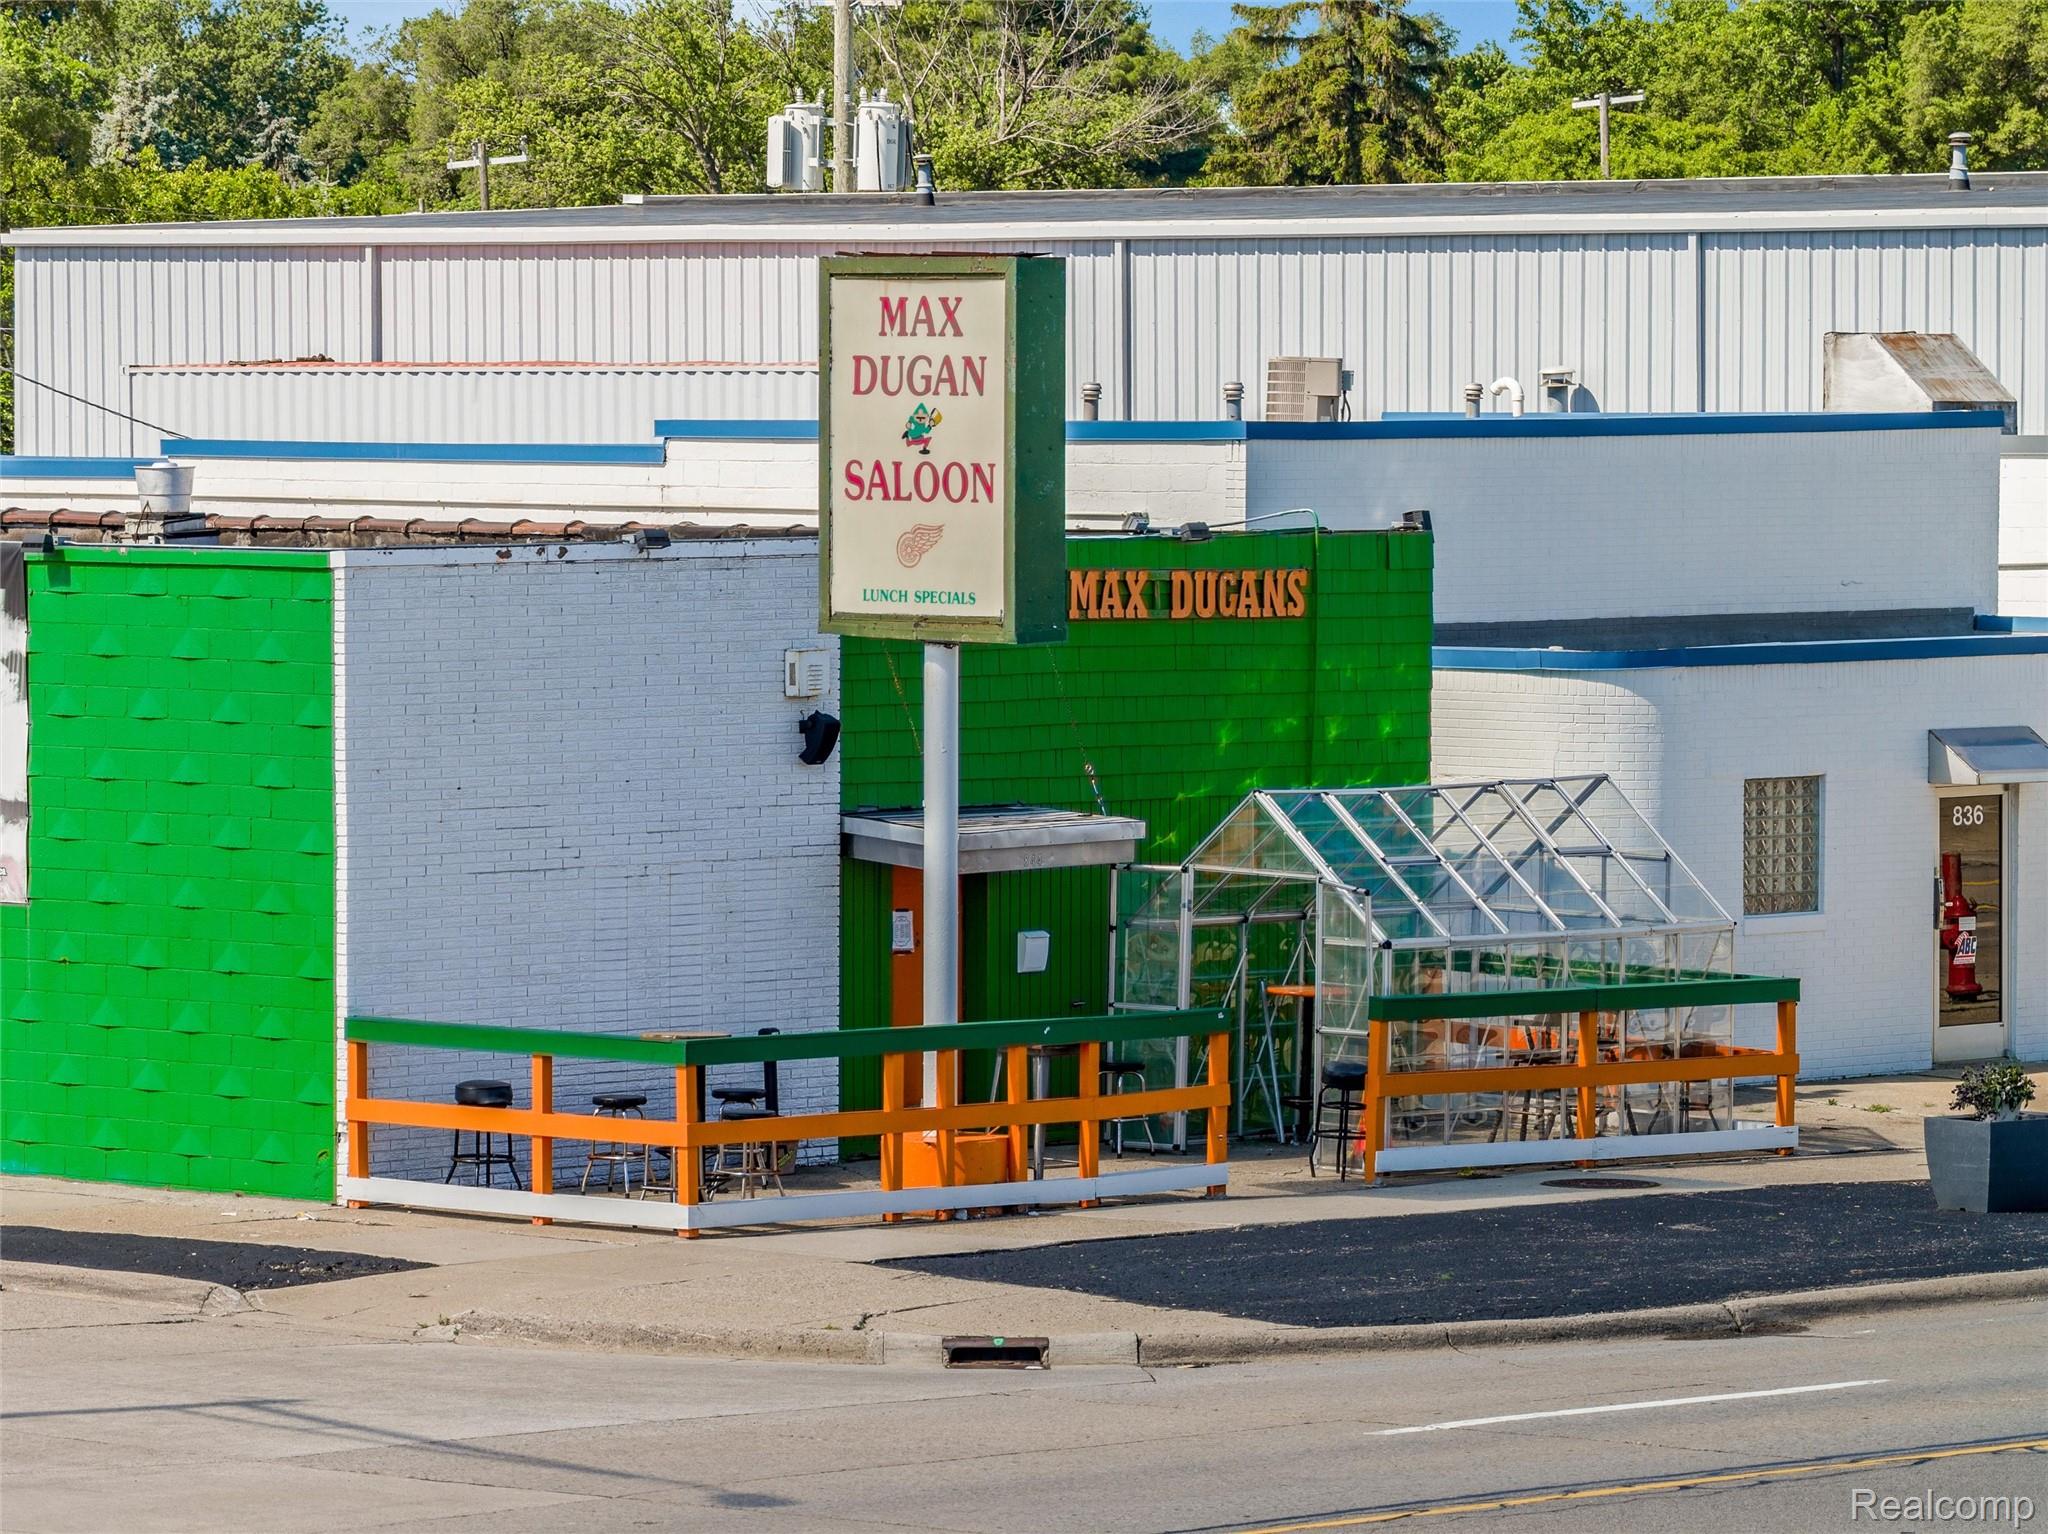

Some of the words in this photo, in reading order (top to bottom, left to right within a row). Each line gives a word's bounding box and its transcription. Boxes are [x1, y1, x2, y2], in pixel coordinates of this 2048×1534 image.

[879, 297, 963, 337] MAX
[852, 355, 987, 397] DUGAN
[844, 460, 996, 504] SALOON
[863, 588, 908, 603] LUNCH
[914, 590, 976, 605] SPECIALS
[1069, 570, 1148, 619] MAX
[1171, 569, 1307, 618] DUGANS
[1953, 805, 1984, 826] 836
[1958, 937, 1977, 955] ABC
